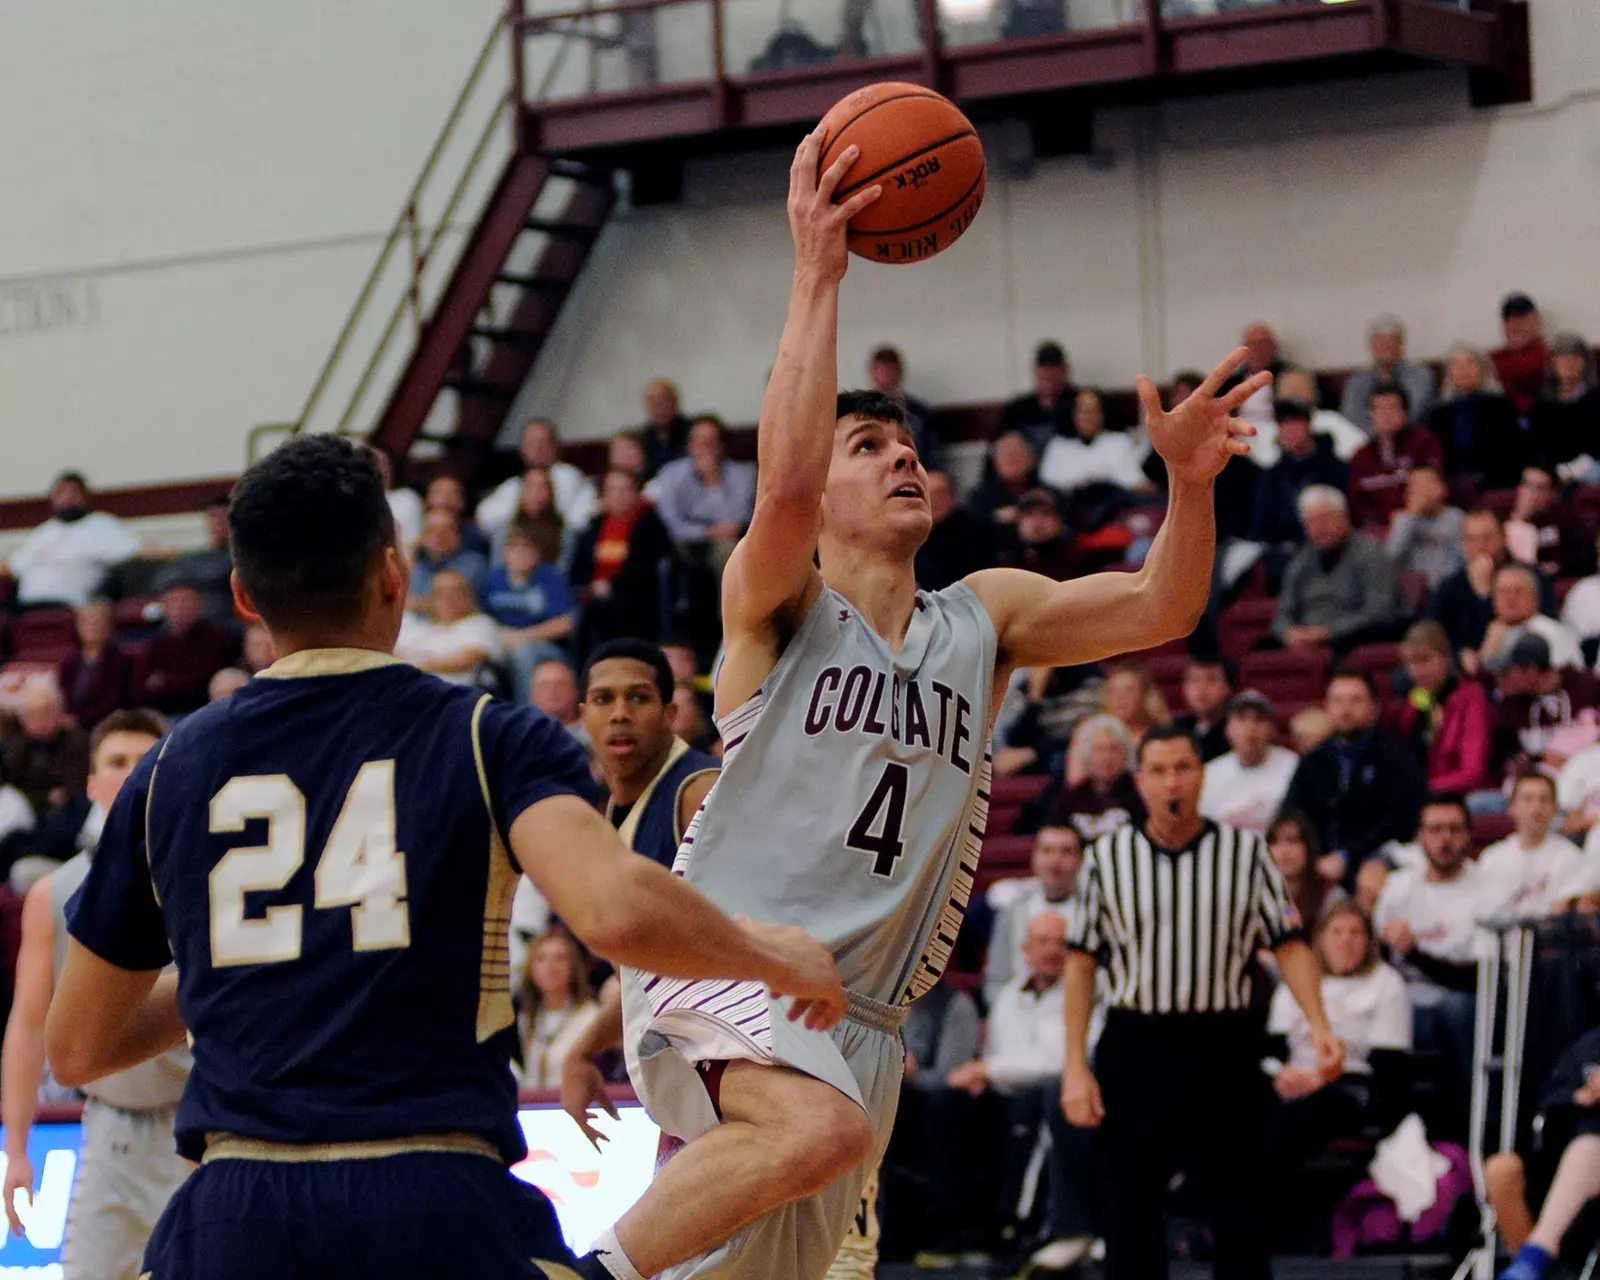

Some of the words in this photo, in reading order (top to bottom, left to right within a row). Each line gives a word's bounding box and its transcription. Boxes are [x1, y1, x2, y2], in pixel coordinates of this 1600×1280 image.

[892, 156, 941, 190] ROCK
[803, 664, 972, 776] COLGATE
[208, 758, 411, 968] 24
[844, 760, 910, 880] 4
